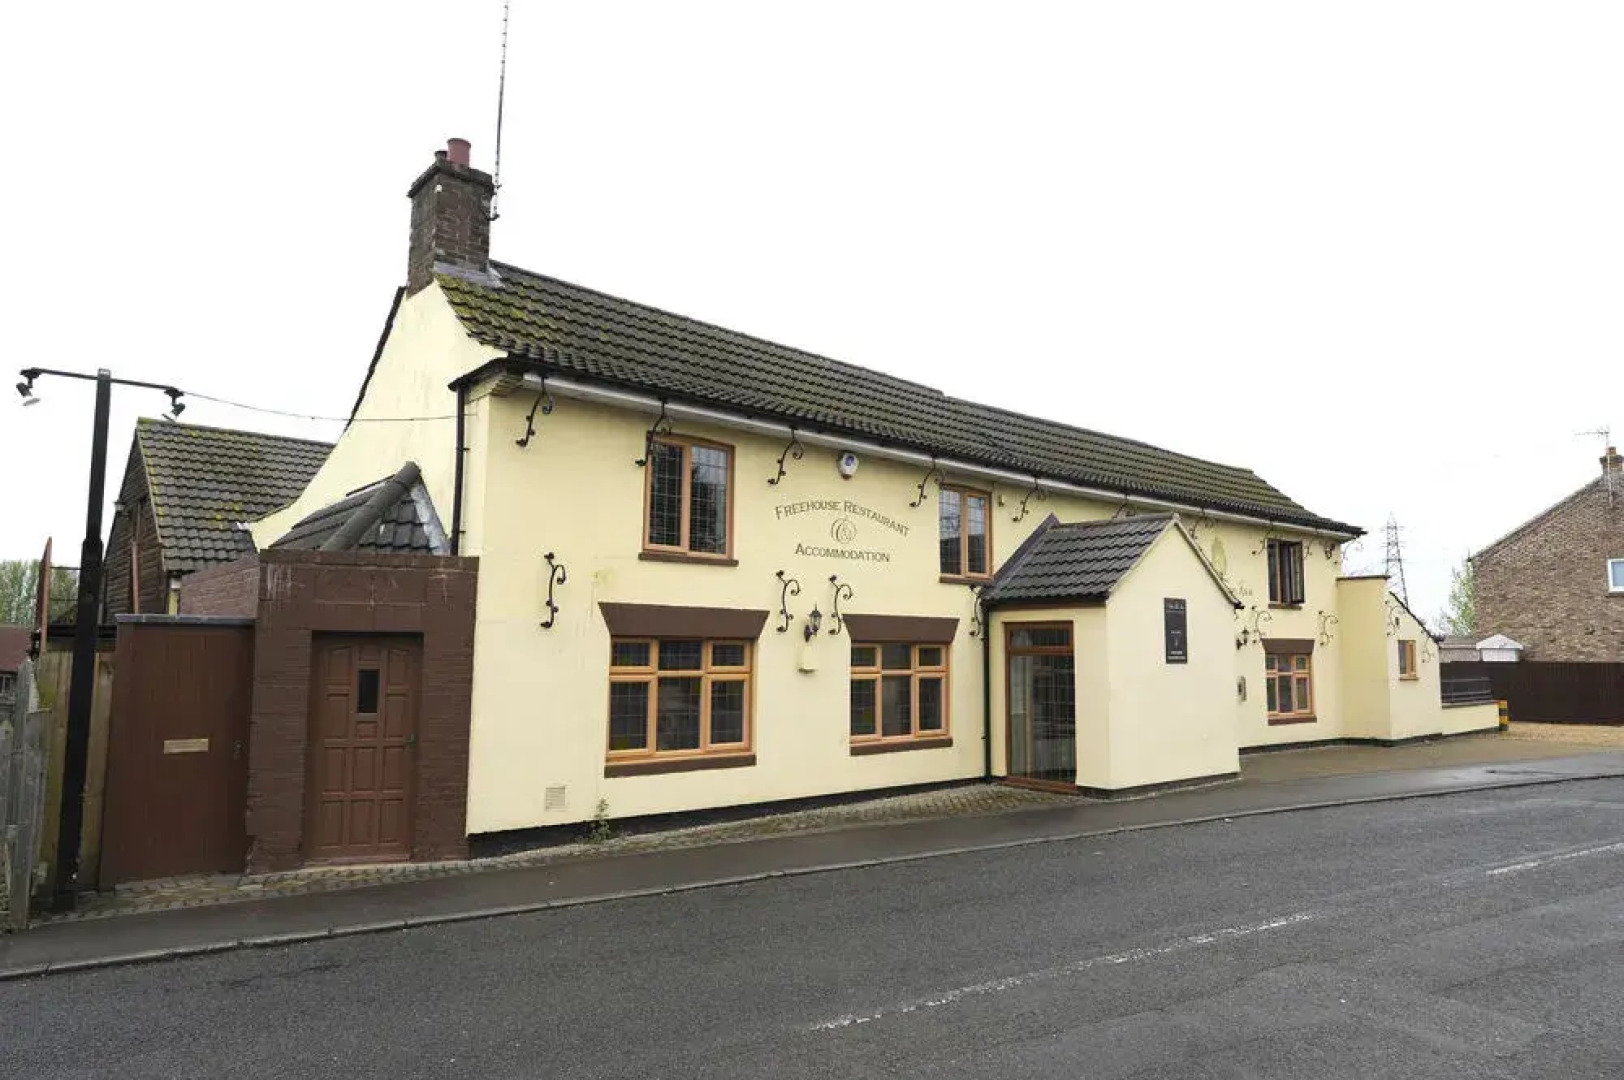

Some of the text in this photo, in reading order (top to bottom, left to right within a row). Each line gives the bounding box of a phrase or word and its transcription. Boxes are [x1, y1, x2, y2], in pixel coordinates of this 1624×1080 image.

[775, 500, 910, 537] FREEHOUSE RESTAURANT
[795, 543, 890, 563] ACCOMMODATION
